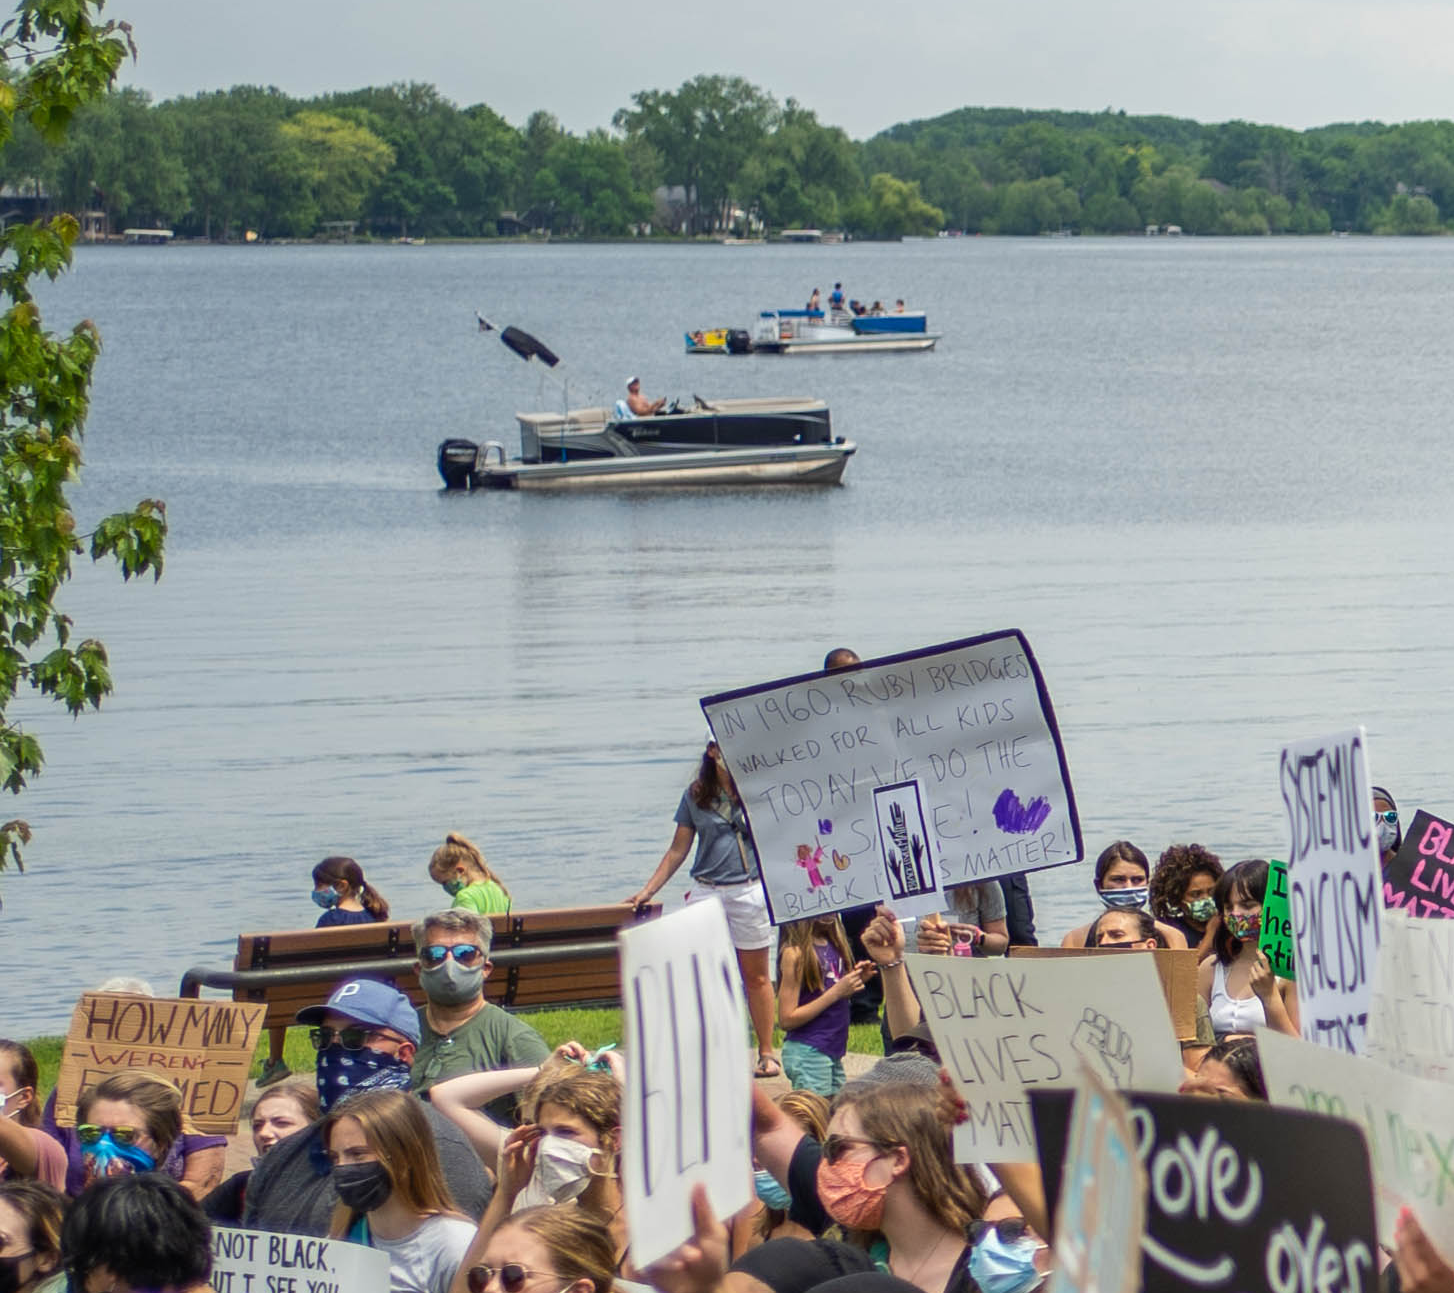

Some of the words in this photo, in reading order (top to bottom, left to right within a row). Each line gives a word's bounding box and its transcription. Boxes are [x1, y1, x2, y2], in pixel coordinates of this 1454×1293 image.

[720, 710, 745, 738] IN
[841, 671, 918, 710] RUBY
[927, 652, 1030, 692] BRIDGES
[736, 739, 822, 774] WALKED
[831, 724, 879, 755] FOR
[894, 713, 943, 739] ALL
[956, 697, 1017, 731] KIDS
[759, 765, 862, 824] TODAY
[928, 749, 968, 784] DO
[975, 735, 1033, 771] THE
[1280, 737, 1370, 869] SYSTEMIC
[848, 788, 981, 856] SE!
[783, 877, 865, 919] BLACK
[964, 822, 1072, 878] MATTER!
[1291, 871, 1382, 1001] RACISM
[86, 998, 178, 1046] HOW
[177, 1003, 262, 1050] MANY
[922, 968, 1044, 1021] BLACK
[80, 1068, 240, 1117] FMED
[950, 1034, 1063, 1083] LIVES
[967, 1098, 1033, 1147] MAT
[215, 1231, 259, 1263] NOT
